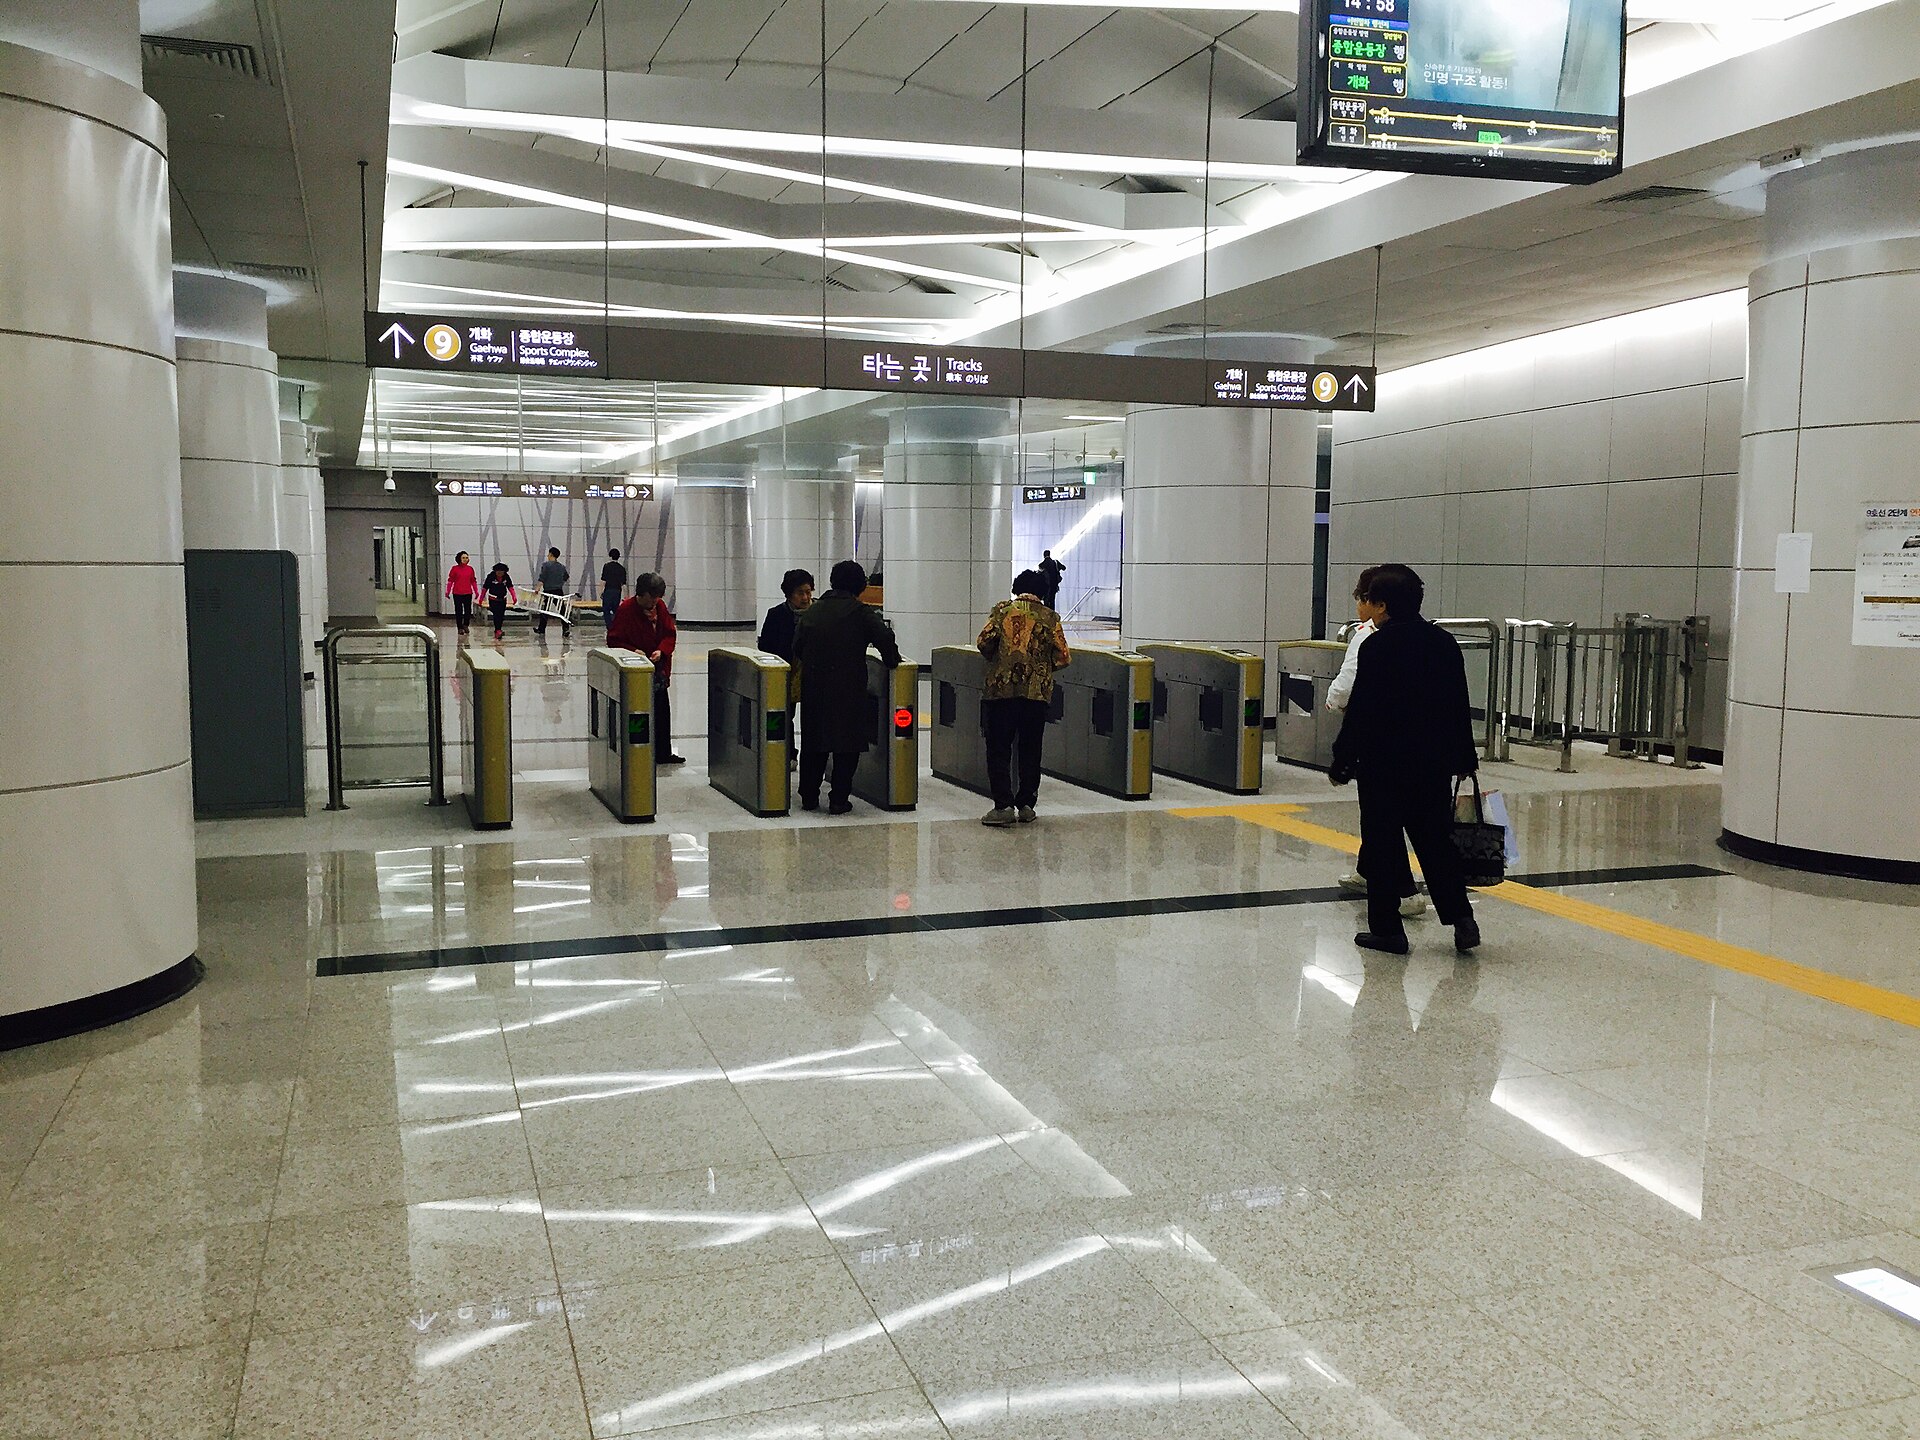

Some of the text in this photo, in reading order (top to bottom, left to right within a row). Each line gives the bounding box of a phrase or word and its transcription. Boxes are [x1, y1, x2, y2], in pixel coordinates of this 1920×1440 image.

[1332, 39, 1405, 60] 종합운동장 행
[1347, 74, 1405, 94] 개화 행
[1423, 71, 1508, 90] 인명 구조 활동!
[1332, 100, 1366, 113] 종합운동장
[468, 326, 492, 341] 개화
[518, 329, 575, 346] 종합운동장
[434, 330, 452, 355] 9
[469, 342, 508, 354] Gaehwa
[519, 345, 590, 360] Sports Complex
[862, 352, 932, 382] 타는 곳
[945, 357, 983, 372] Tracks
[965, 374, 990, 385] のりば
[1225, 368, 1243, 381] 개화
[1266, 370, 1308, 384] 종합운동장
[1213, 381, 1242, 391] Gaehwa
[1255, 382, 1307, 395] Sports Complex
[1319, 377, 1332, 398] 9
[1887, 508, 1908, 518] 2단계
